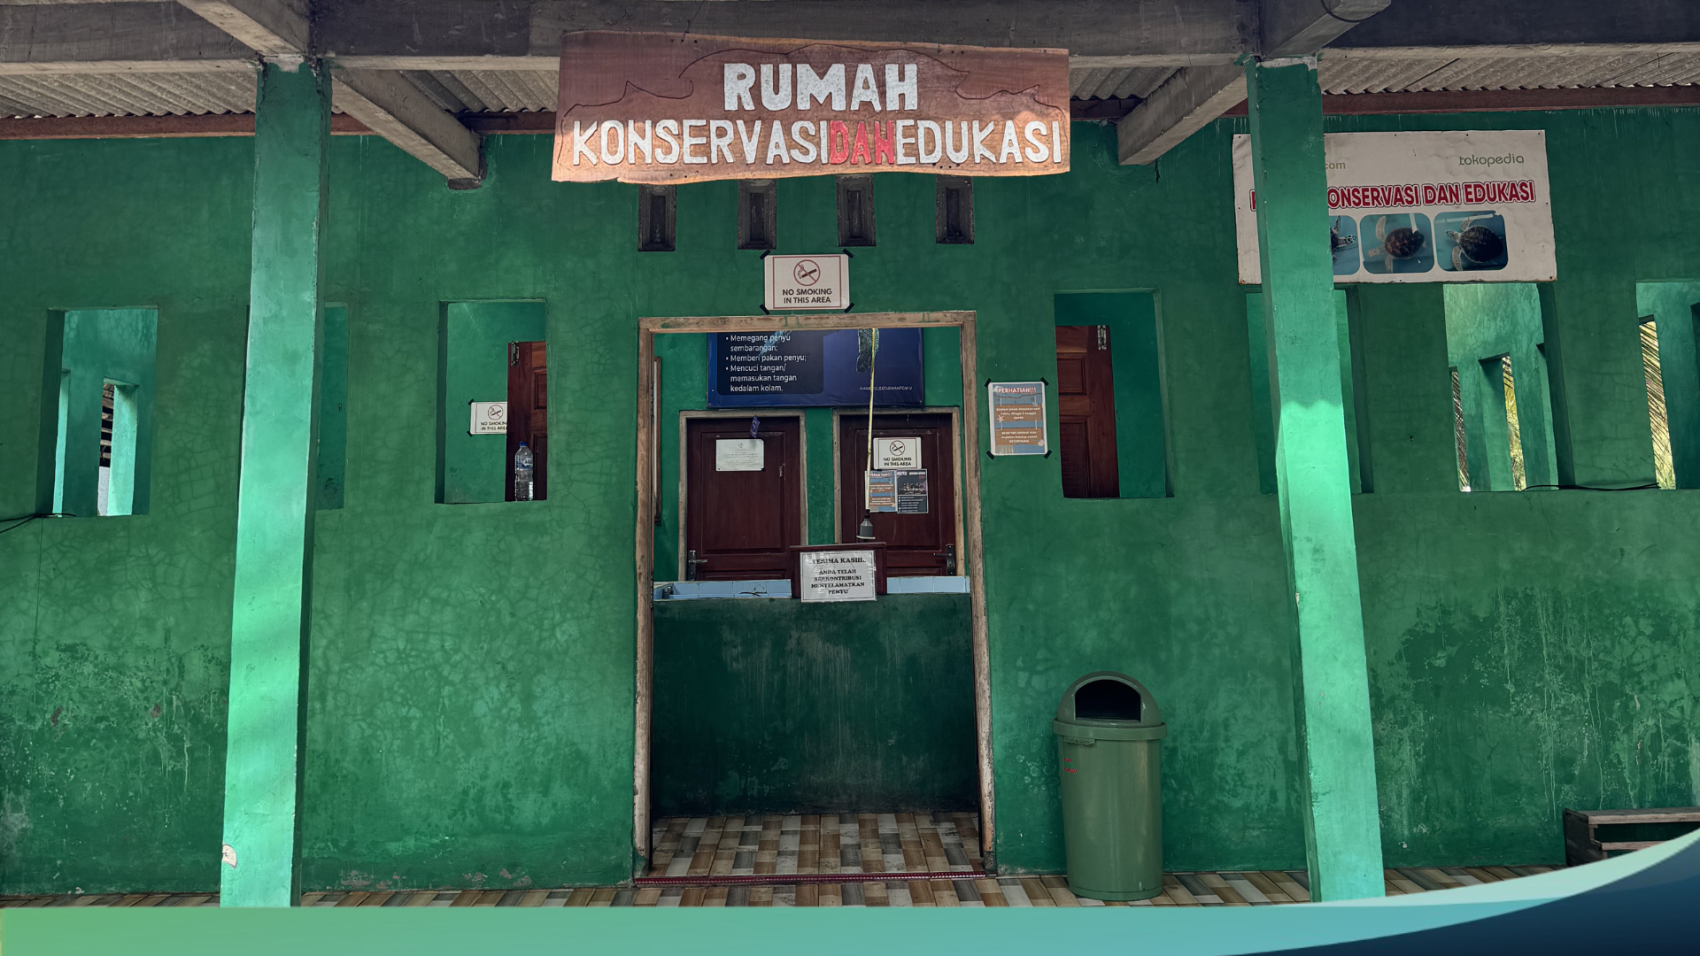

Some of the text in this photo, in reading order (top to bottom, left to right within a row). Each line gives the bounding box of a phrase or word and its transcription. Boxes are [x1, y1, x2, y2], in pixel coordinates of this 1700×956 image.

[723, 63, 918, 112] RUMAH
[572, 119, 1061, 167] KONSERVASI DAN EDUKASI
[1458, 153, 1525, 168] tokopedia
[1327, 180, 1536, 209] ONSERVASI DAN EDUKASI
[782, 288, 832, 296] NO SMOKING
[730, 335, 791, 343] Memegang penyu
[730, 354, 760, 362] Memberi
[761, 354, 783, 362] pakan
[730, 364, 759, 372] Mencuci
[730, 374, 797, 383] memasukan tangan
[730, 384, 760, 392] kedalam
